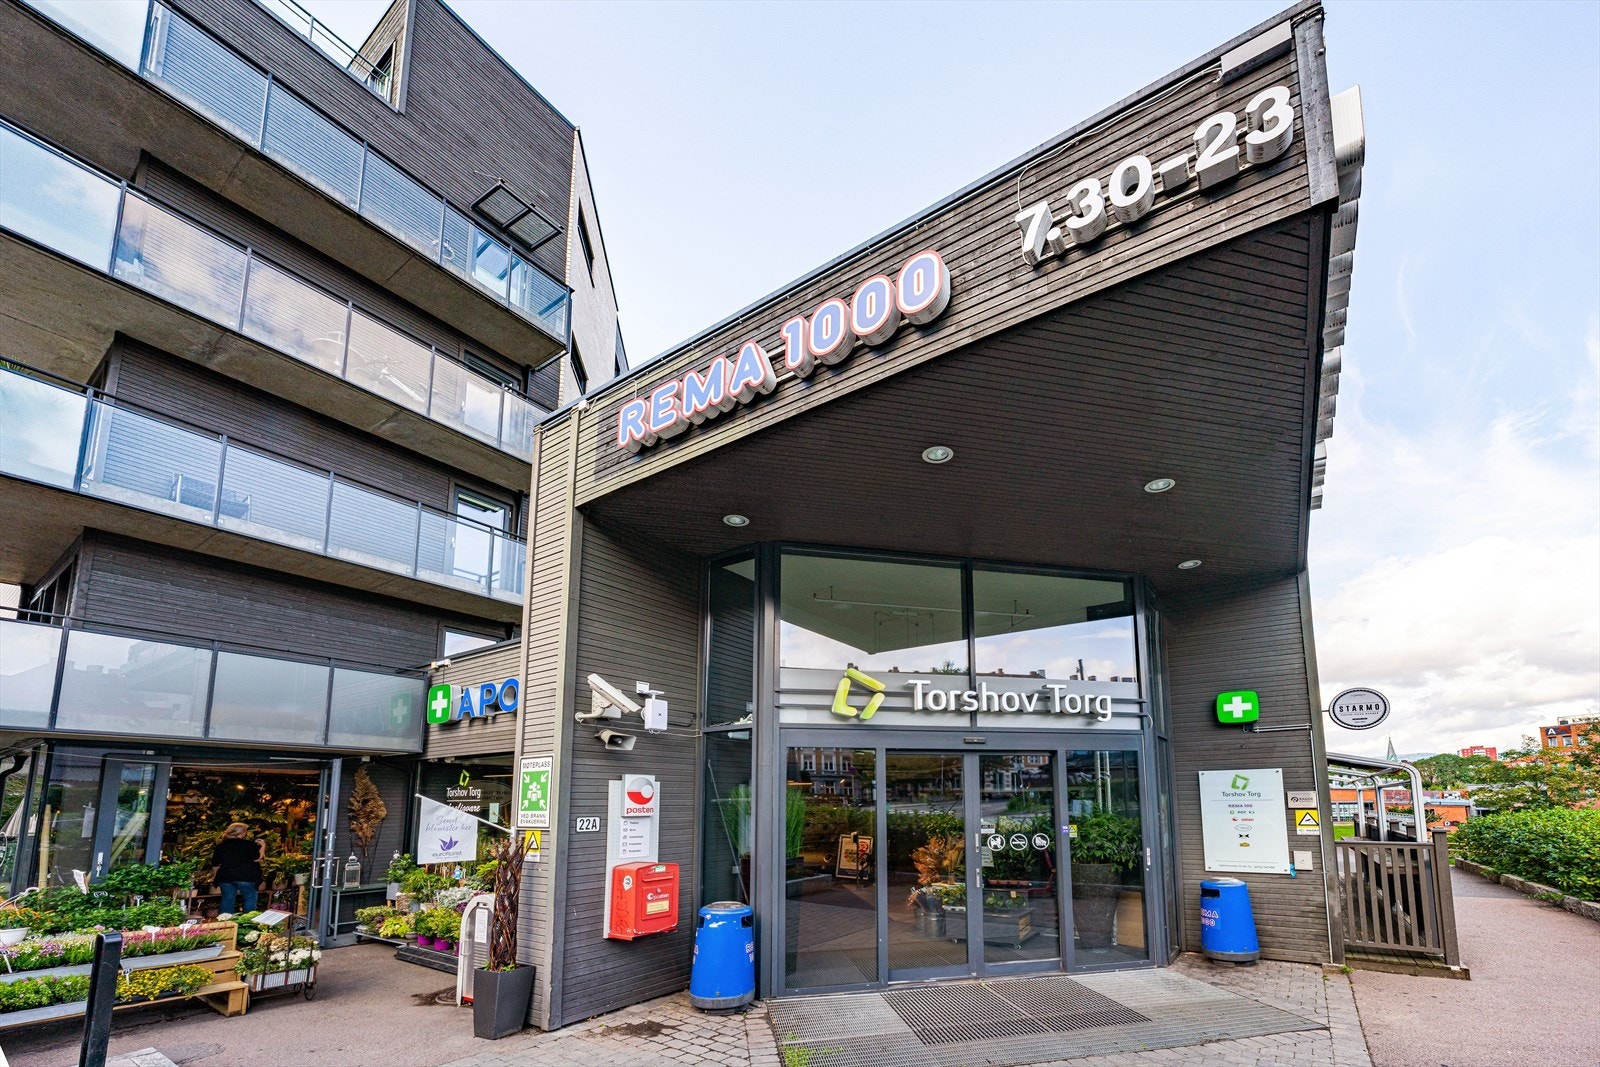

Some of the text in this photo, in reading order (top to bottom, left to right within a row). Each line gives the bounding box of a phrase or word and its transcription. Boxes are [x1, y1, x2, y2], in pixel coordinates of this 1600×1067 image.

[1015, 86, 1294, 266] 7.30-23
[617, 250, 950, 452] REMA 1000
[457, 678, 519, 719] APO
[905, 680, 1112, 722] Torshov Torg
[446, 787, 468, 797] Torshov
[468, 786, 481, 799] Torg
[626, 806, 655, 815] posten
[578, 818, 598, 831] 22A
